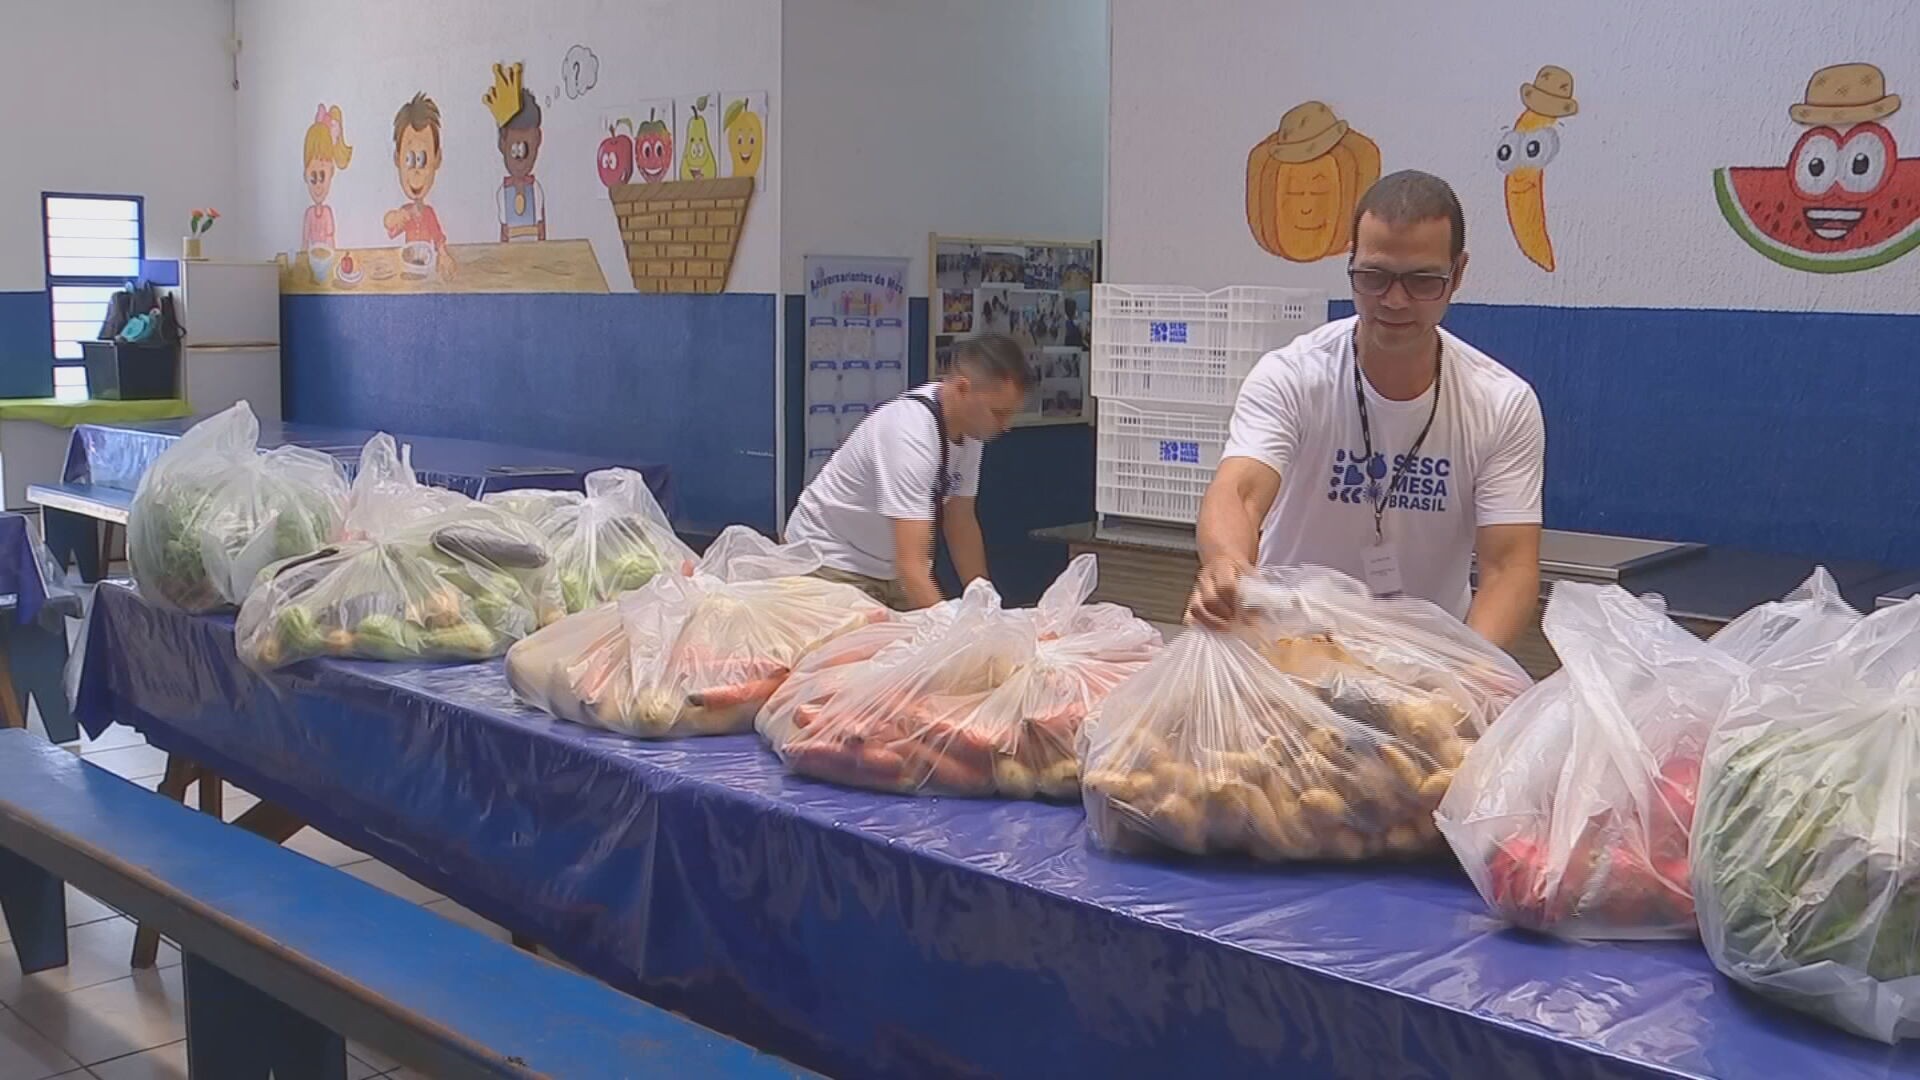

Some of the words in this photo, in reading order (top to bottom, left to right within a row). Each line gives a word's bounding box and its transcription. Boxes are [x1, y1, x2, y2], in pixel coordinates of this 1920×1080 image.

[1392, 454, 1451, 477] SESC
[1390, 475, 1447, 497] MESA
[1388, 495, 1446, 512] BRASIL
